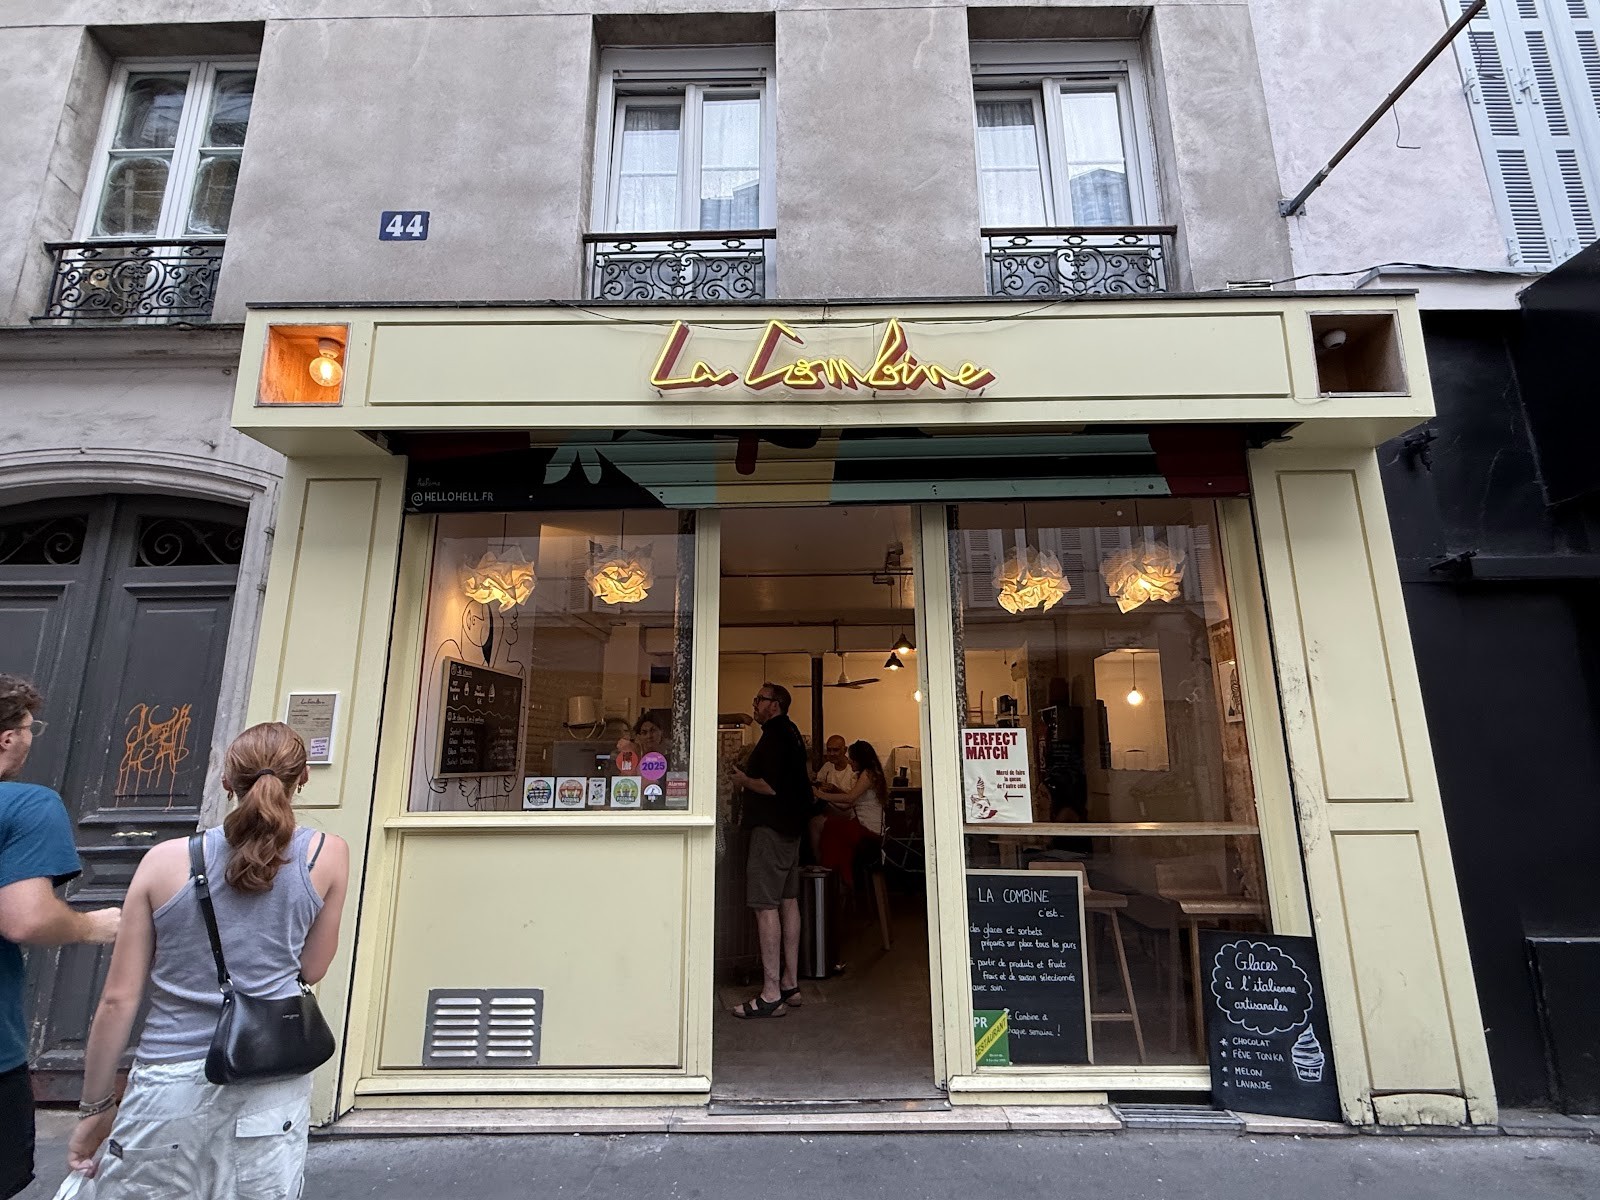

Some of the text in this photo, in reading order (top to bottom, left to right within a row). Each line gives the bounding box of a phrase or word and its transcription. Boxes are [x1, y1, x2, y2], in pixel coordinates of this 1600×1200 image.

[385, 214, 424, 237] 44
[650, 318, 996, 391] La Combine
[411, 491, 494, 506] @HELLOHELL.FR
[964, 732, 1018, 746] PERFECT
[965, 746, 1009, 760] MATCH
[641, 761, 666, 771] 2025
[978, 887, 995, 903] LA
[983, 922, 1003, 939] glaces
[1005, 925, 1015, 935] et
[1017, 925, 1043, 936] sorbets
[1006, 940, 1016, 948] sur
[1018, 937, 1034, 952] place
[1035, 938, 1050, 949] tous
[1051, 938, 1060, 948] les
[1060, 942, 1077, 953] jours
[977, 957, 996, 971] partir
[997, 957, 1007, 967] de
[1008, 958, 1035, 973] produits
[1036, 959, 1044, 969] et
[1047, 958, 1067, 969] fruits
[1234, 951, 1278, 972] Glaces
[999, 971, 1007, 981] et
[1008, 972, 1017, 981] de
[1018, 974, 1037, 982] saison
[972, 984, 988, 992] avec
[1224, 974, 1297, 995] à l'italienne
[1234, 997, 1289, 1013] artisanales
[1014, 1010, 1040, 1021] Combine
[1007, 1025, 1027, 1040] haque
[1232, 1036, 1271, 1048] CHOCOLAT
[1232, 1048, 1285, 1063] FÈVE TONKA
[1234, 1066, 1263, 1077] MELON
[1235, 1080, 1273, 1091] LAVANDE
